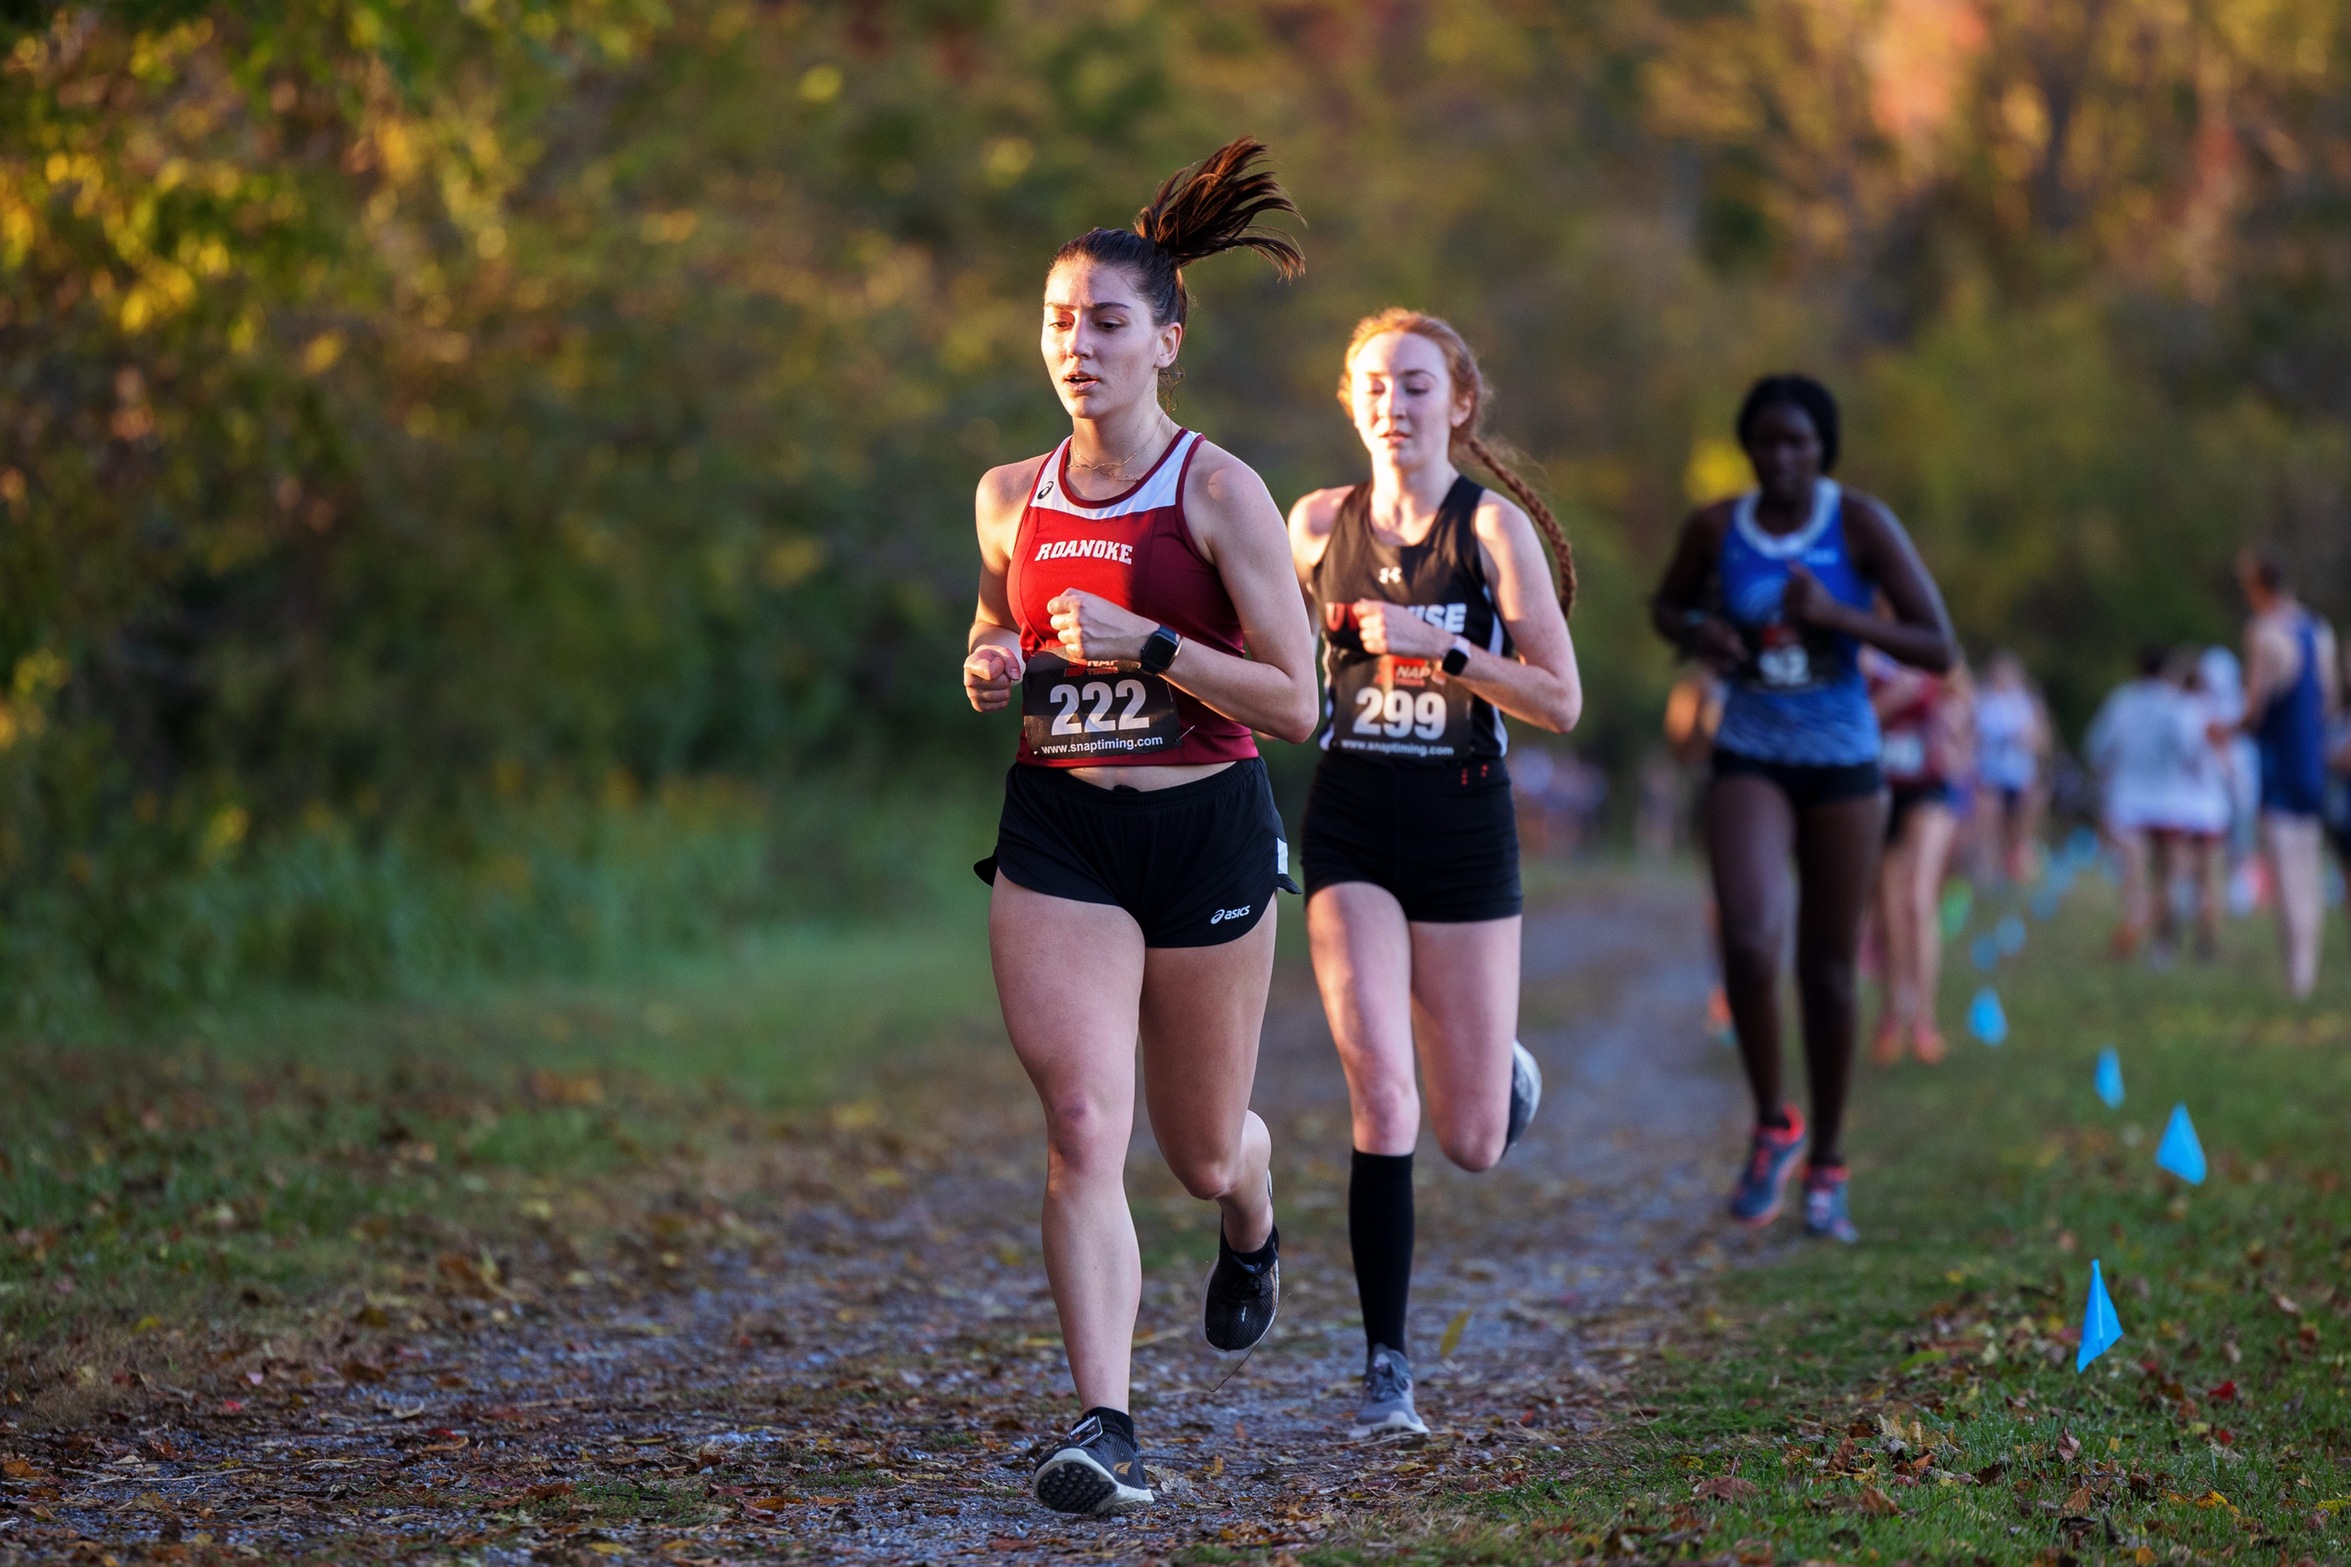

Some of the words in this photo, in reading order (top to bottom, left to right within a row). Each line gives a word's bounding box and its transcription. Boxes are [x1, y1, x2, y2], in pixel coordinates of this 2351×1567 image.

[1034, 539, 1133, 565] ROANOKE
[1050, 679, 1150, 736] 222
[1352, 687, 1447, 740] 299
[1041, 735, 1163, 755] www.snaptiming.com
[1340, 738, 1454, 758] www.snaptiming.com
[1224, 905, 1250, 920] asics
